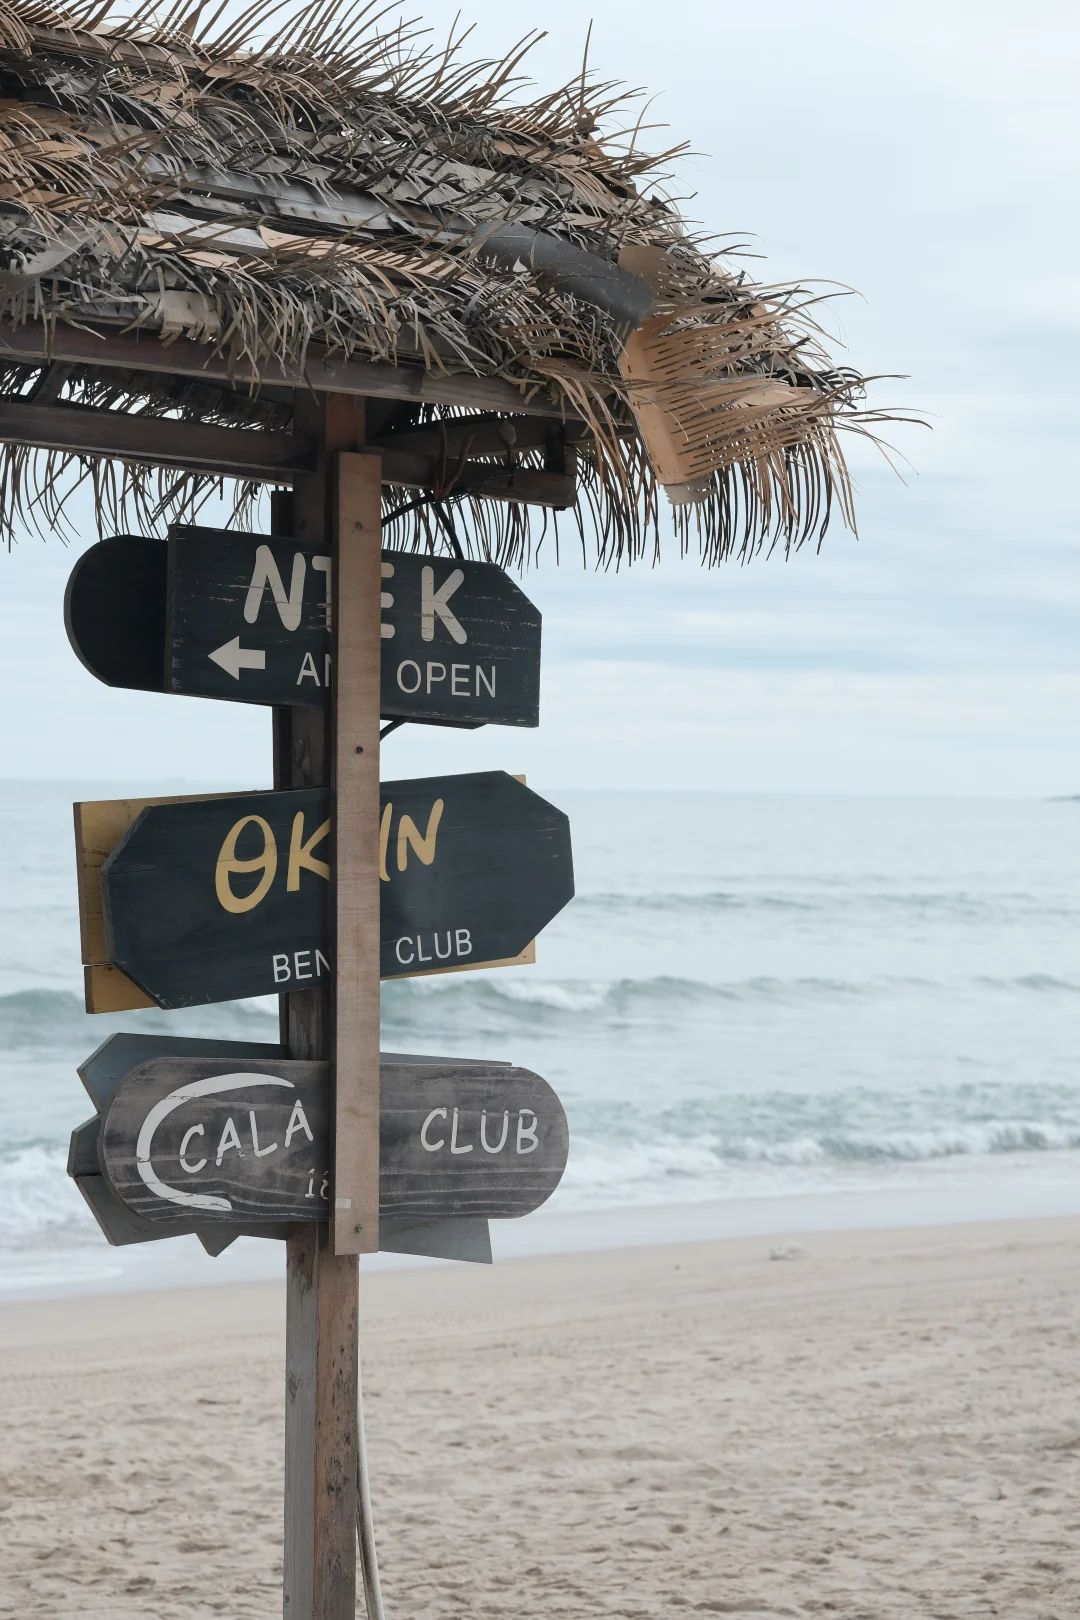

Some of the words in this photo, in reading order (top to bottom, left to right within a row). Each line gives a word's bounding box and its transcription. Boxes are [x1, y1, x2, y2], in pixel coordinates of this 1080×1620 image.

[396, 659, 496, 698] OPEN
[395, 928, 473, 965] CLUB
[179, 1099, 314, 1174] CALA
[420, 1107, 539, 1155] CLUB
